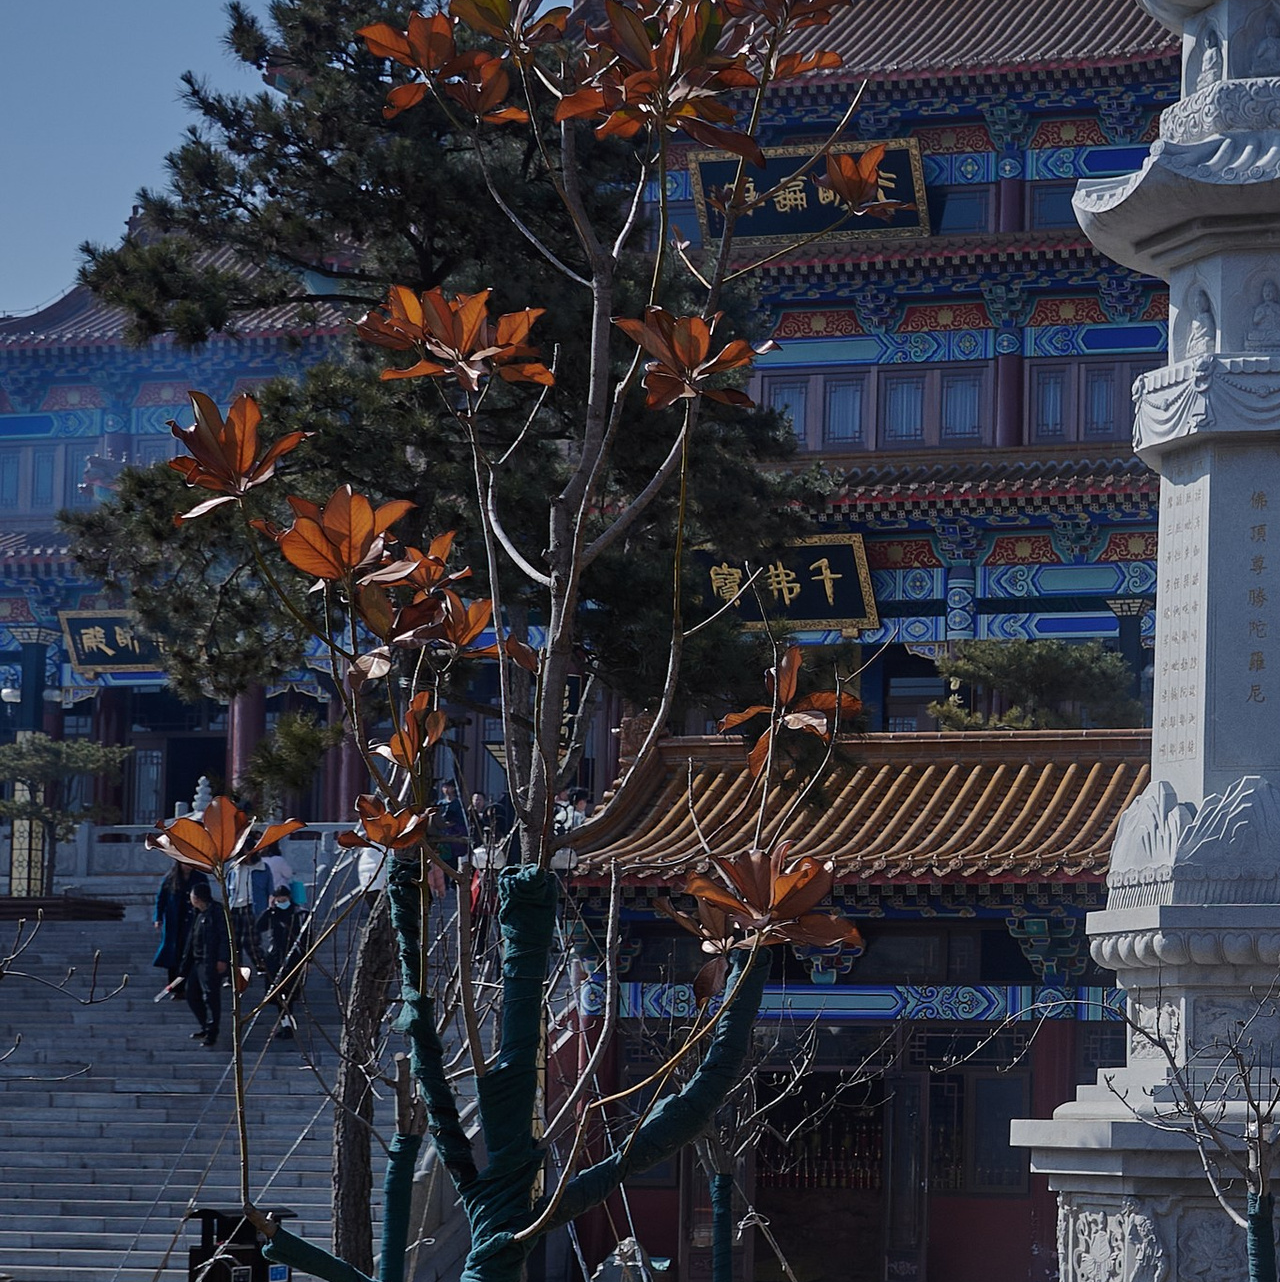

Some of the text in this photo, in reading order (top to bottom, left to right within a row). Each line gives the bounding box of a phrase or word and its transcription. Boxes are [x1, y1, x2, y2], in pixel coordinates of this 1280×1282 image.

[1245, 490, 1269, 704] 佛頂尊勝陀羅尼
